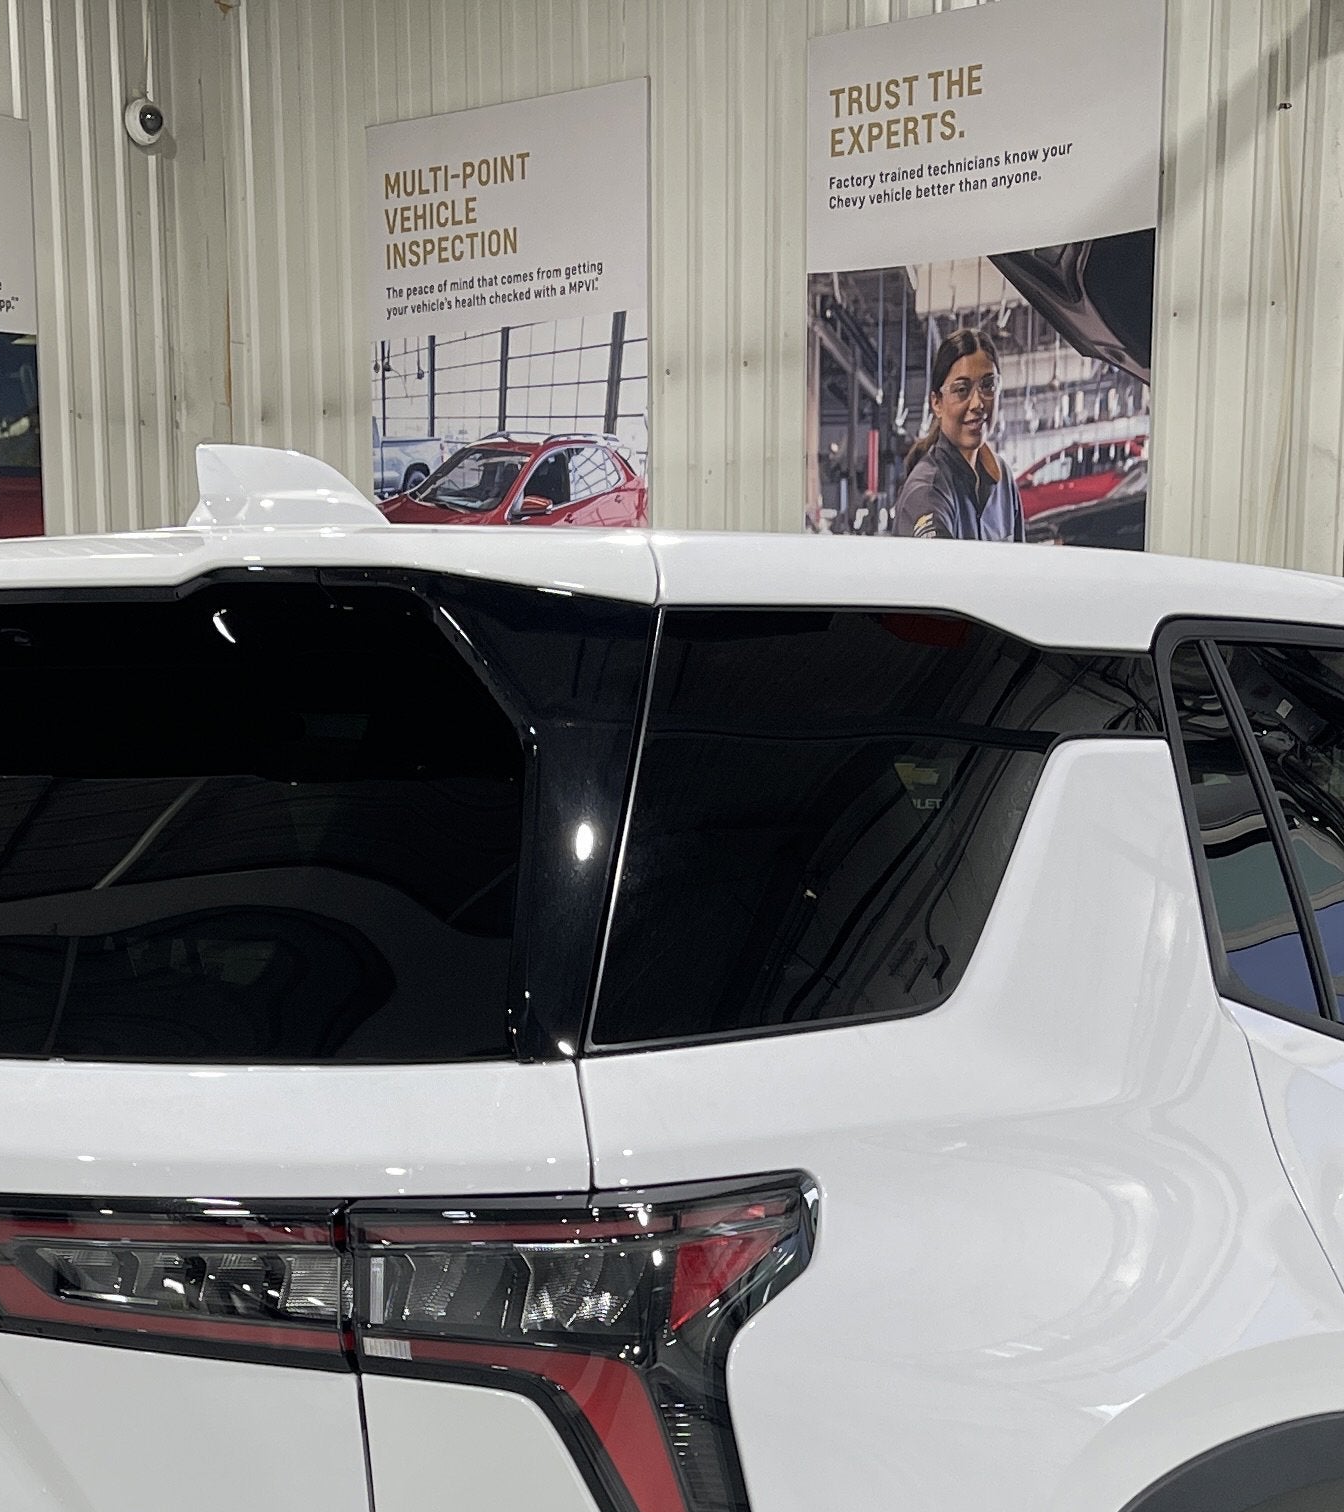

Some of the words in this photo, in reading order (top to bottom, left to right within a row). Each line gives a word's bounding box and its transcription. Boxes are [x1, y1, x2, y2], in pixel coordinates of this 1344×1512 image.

[830, 75, 919, 118] TRUST
[927, 63, 983, 102] THE
[830, 109, 965, 158] EXPERTS.
[384, 152, 530, 200] MULTI-POINT
[829, 173, 876, 190] Factory
[879, 164, 924, 183] trained
[927, 155, 1001, 177] technicians
[1004, 149, 1039, 166] know
[1042, 142, 1073, 162] your
[829, 195, 866, 210] Chevy
[869, 186, 912, 205] vehicle
[916, 182, 954, 200] better
[959, 177, 988, 193] than
[991, 169, 1042, 188] anyone.
[384, 197, 477, 235] VEHICLE
[386, 227, 517, 270] INSPECTION
[386, 287, 404, 300] The
[407, 283, 435, 299] peace
[437, 279, 448, 293] of
[450, 276, 474, 292] mind
[477, 273, 498, 288] that
[501, 271, 534, 285] comes
[537, 266, 562, 281] from
[565, 260, 603, 279] getting
[386, 304, 408, 320] your
[411, 296, 452, 314] vehicle's
[455, 294, 486, 309] health
[489, 290, 531, 305] checked
[534, 286, 557, 299] with
[559, 286, 566, 296] a
